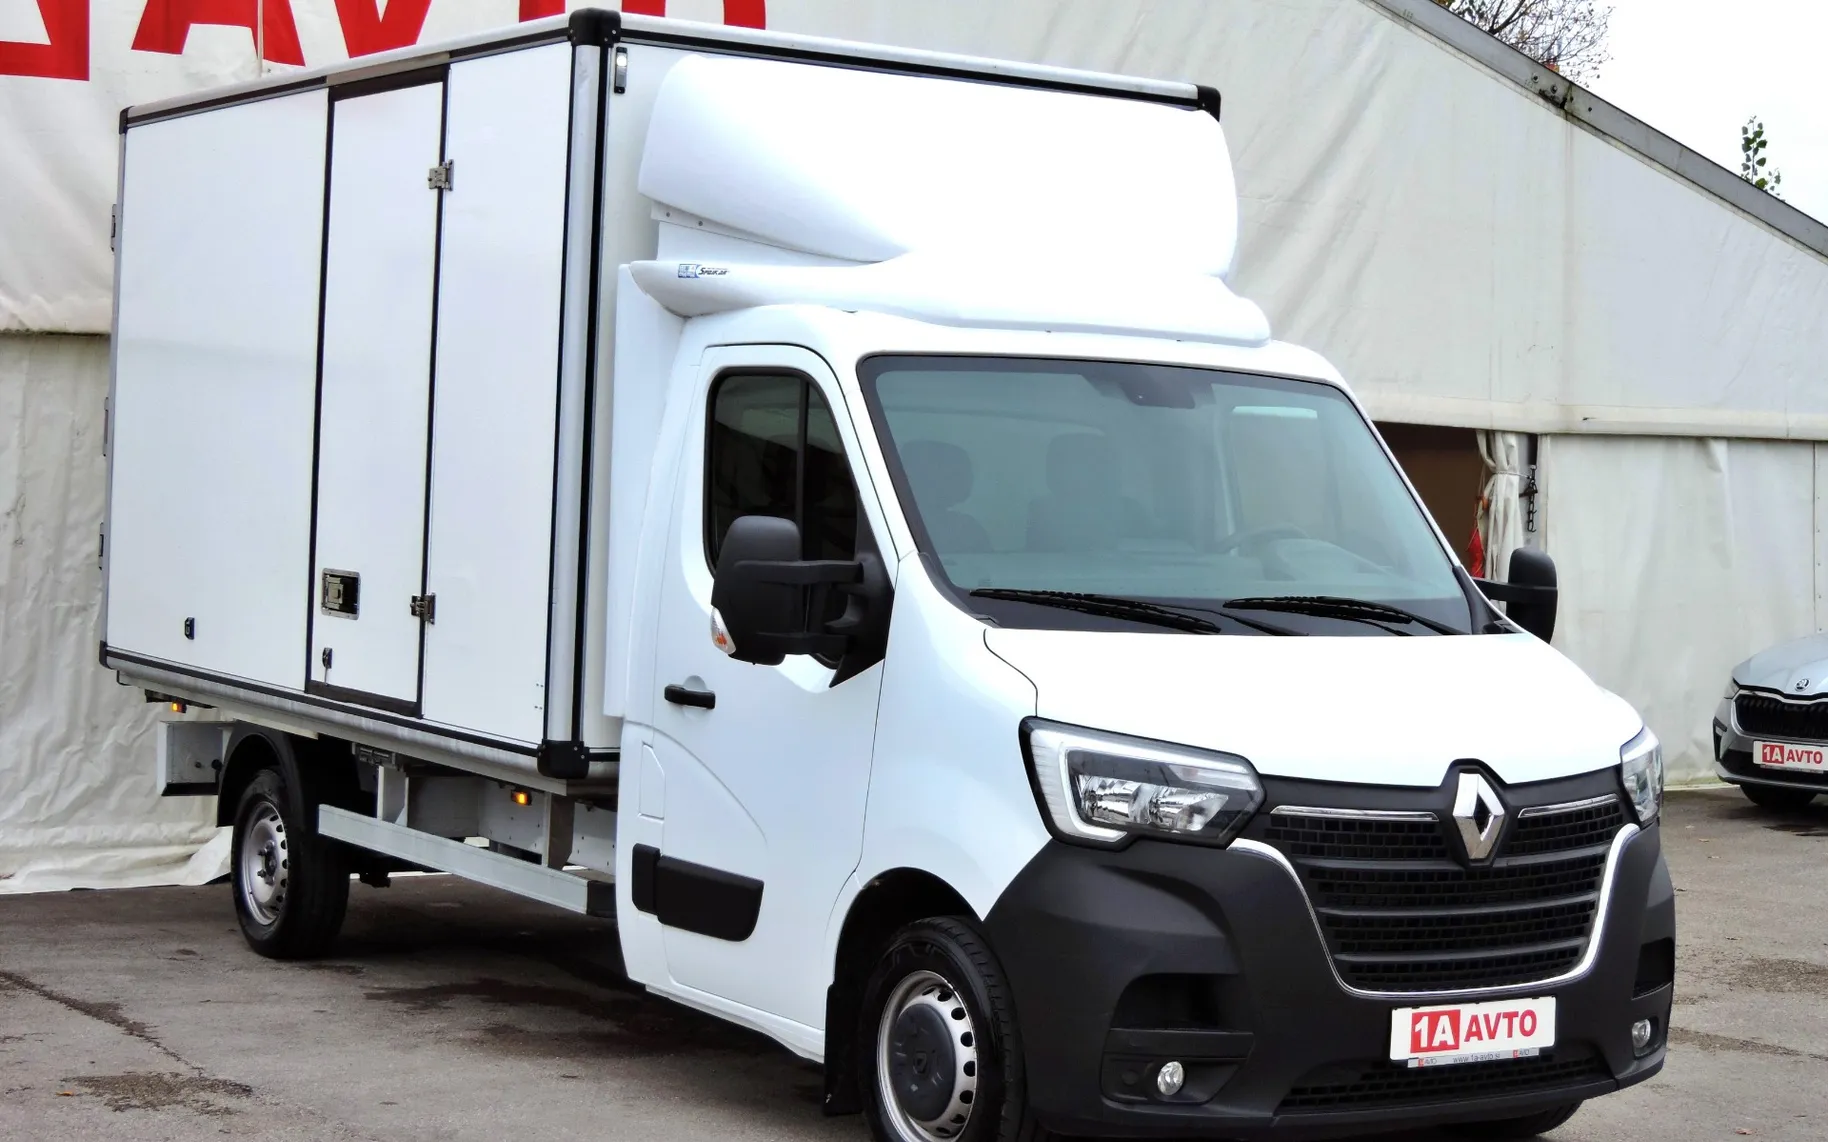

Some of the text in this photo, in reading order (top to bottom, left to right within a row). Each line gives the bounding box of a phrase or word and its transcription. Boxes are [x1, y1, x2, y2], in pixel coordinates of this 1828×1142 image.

[1763, 746, 1823, 764] 1A AVTO
[1414, 1009, 1537, 1049] 1A AVTO
